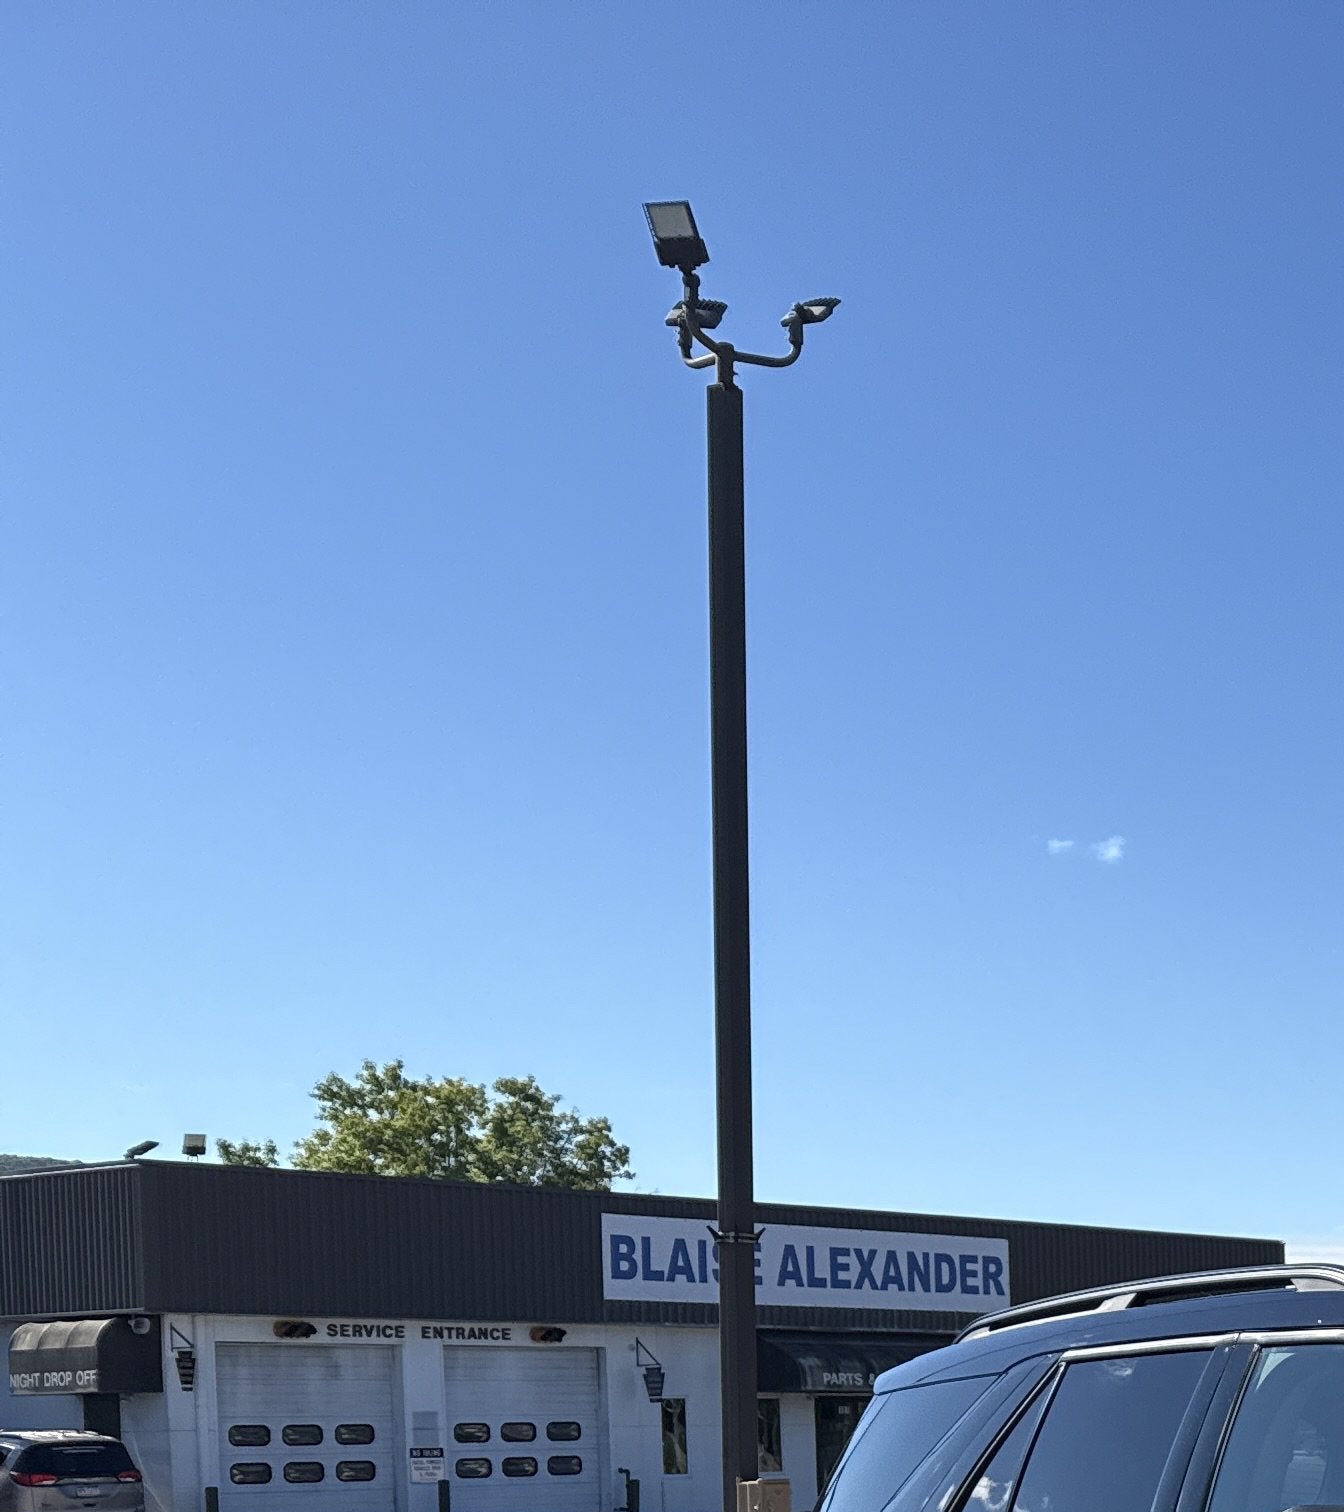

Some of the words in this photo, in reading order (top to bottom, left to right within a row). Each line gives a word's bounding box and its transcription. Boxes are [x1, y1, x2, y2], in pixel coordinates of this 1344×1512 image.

[609, 1233, 763, 1286] BLAI
[777, 1243, 1006, 1296] ALEXANDER
[326, 1323, 406, 1339] SERVICE
[421, 1325, 512, 1341] ENTRANCE
[9, 1372, 40, 1388] NIGHT
[43, 1371, 73, 1387] DROP
[75, 1369, 98, 1386] OFF
[823, 1372, 864, 1386] PARTS
